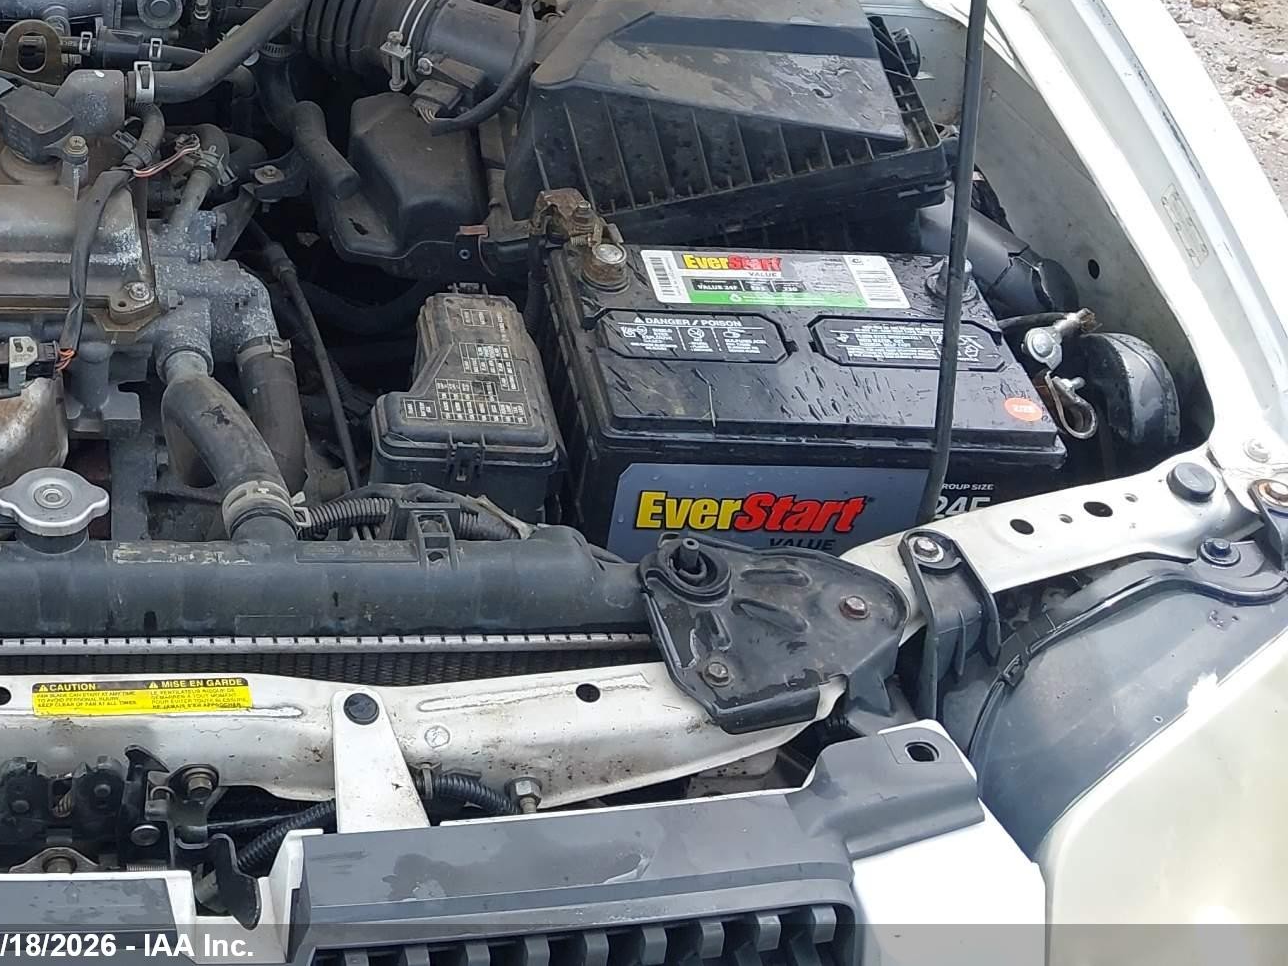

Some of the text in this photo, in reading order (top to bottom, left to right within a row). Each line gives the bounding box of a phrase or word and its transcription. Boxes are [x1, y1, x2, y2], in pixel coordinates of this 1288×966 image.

[682, 253, 783, 272] EverStart
[645, 317, 691, 326] DANGER
[700, 319, 743, 327] POISON
[971, 483, 995, 491] SIZE
[634, 490, 866, 532] EverStart
[768, 537, 835, 552] VALUE
[49, 683, 97, 692] CAUTION
[161, 677, 243, 689] MISE EN GARDE
